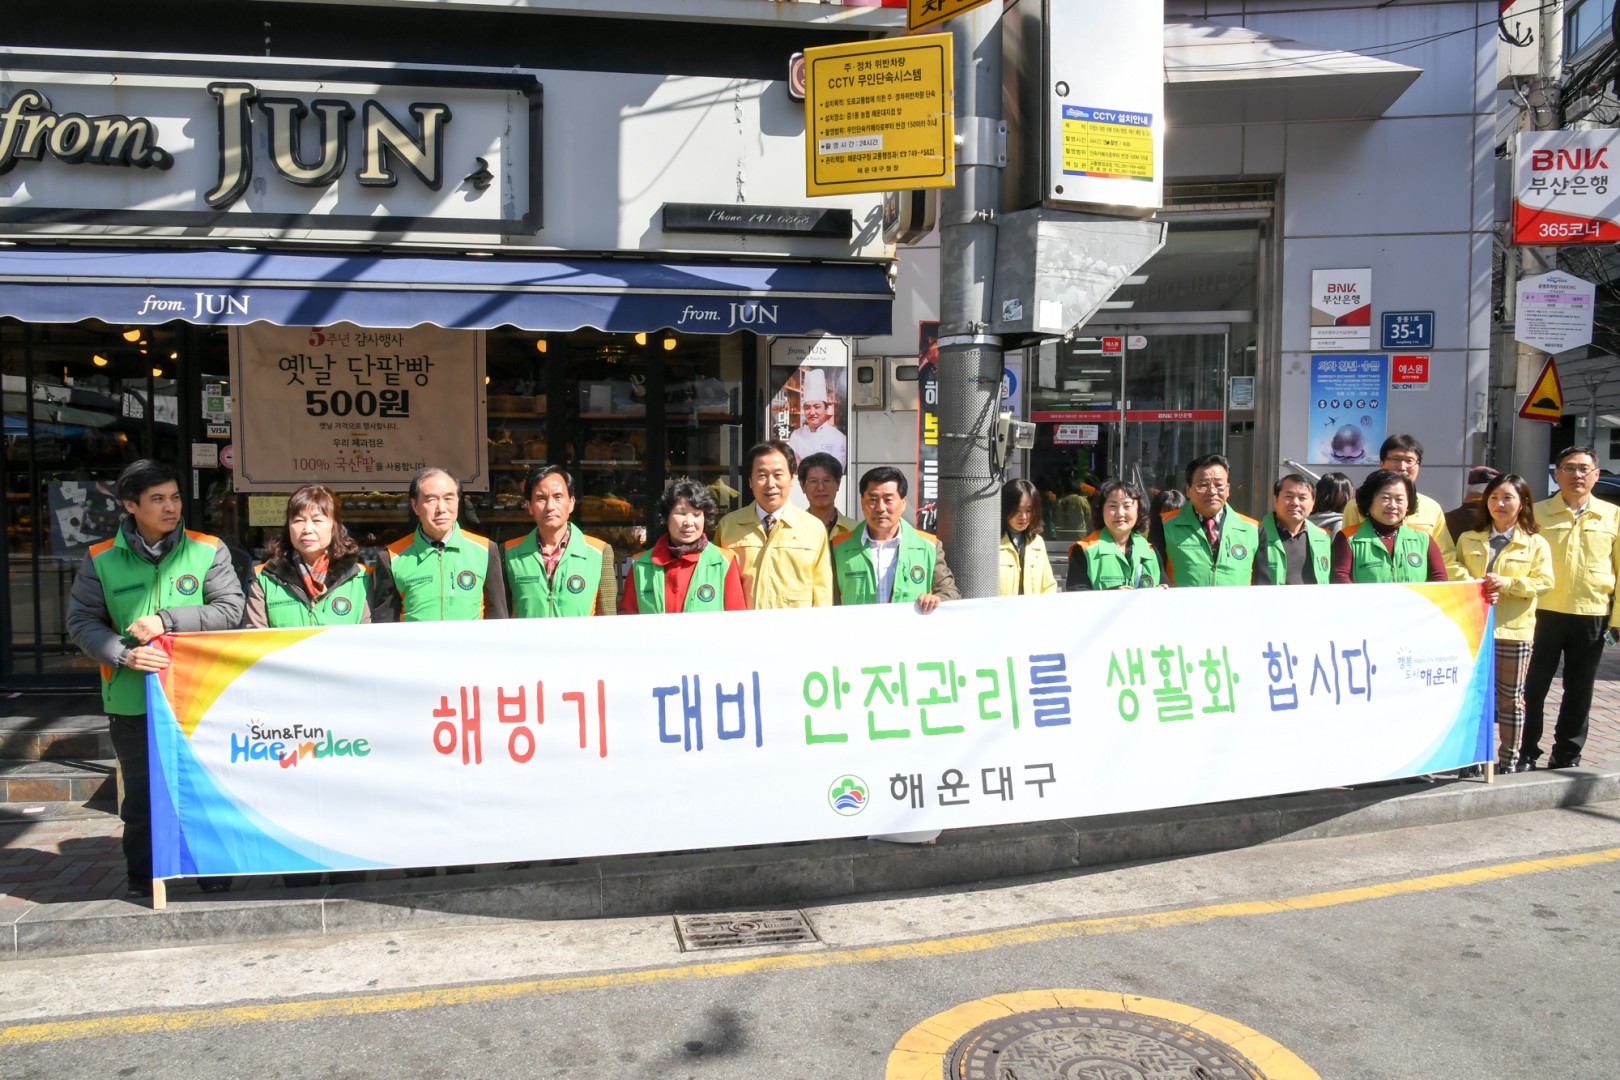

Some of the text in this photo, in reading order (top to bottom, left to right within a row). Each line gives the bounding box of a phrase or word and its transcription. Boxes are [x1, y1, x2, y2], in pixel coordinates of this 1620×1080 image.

[875, 57, 905, 69] 위반차량
[828, 68, 922, 89] CCTV 무인단속시스템
[925, 90, 936, 98] 단속
[907, 120, 925, 128] 150미터
[1093, 111, 1116, 121] CCTV
[1118, 114, 1148, 125] 설치안내
[0, 82, 452, 209] from. JUN
[859, 138, 879, 147] 24시간
[848, 153, 871, 163] 해운대구청
[1532, 147, 1608, 171] BNK
[1528, 176, 1608, 196] 부산은행
[708, 209, 742, 221] Phone
[1539, 221, 1600, 237] 365코너
[1327, 283, 1356, 293] BNK
[138, 293, 250, 318] from. JUN
[1322, 295, 1360, 305] 부산은행
[677, 303, 779, 328] from. JUN
[308, 326, 404, 348] 5주년 감사행사
[1391, 323, 1424, 339] 35-1
[808, 345, 827, 356] JUN
[278, 353, 435, 387] 옛날 단팥빵
[1398, 364, 1423, 374] 에스원
[306, 389, 410, 418] 500원
[335, 422, 362, 430] 가격으로
[363, 422, 399, 431] 행사합니다.
[333, 438, 384, 448] 우리 제과점은
[293, 457, 330, 471] 100%
[334, 456, 384, 473] 국산팥을
[1420, 666, 1458, 687] 해운대
[432, 639, 1378, 765] 해빙기 대비 안전관리를 생활화 합시다
[251, 724, 324, 740] Sun&Fun
[230, 730, 371, 768] Haeundae
[889, 762, 1057, 809] 해운대구
